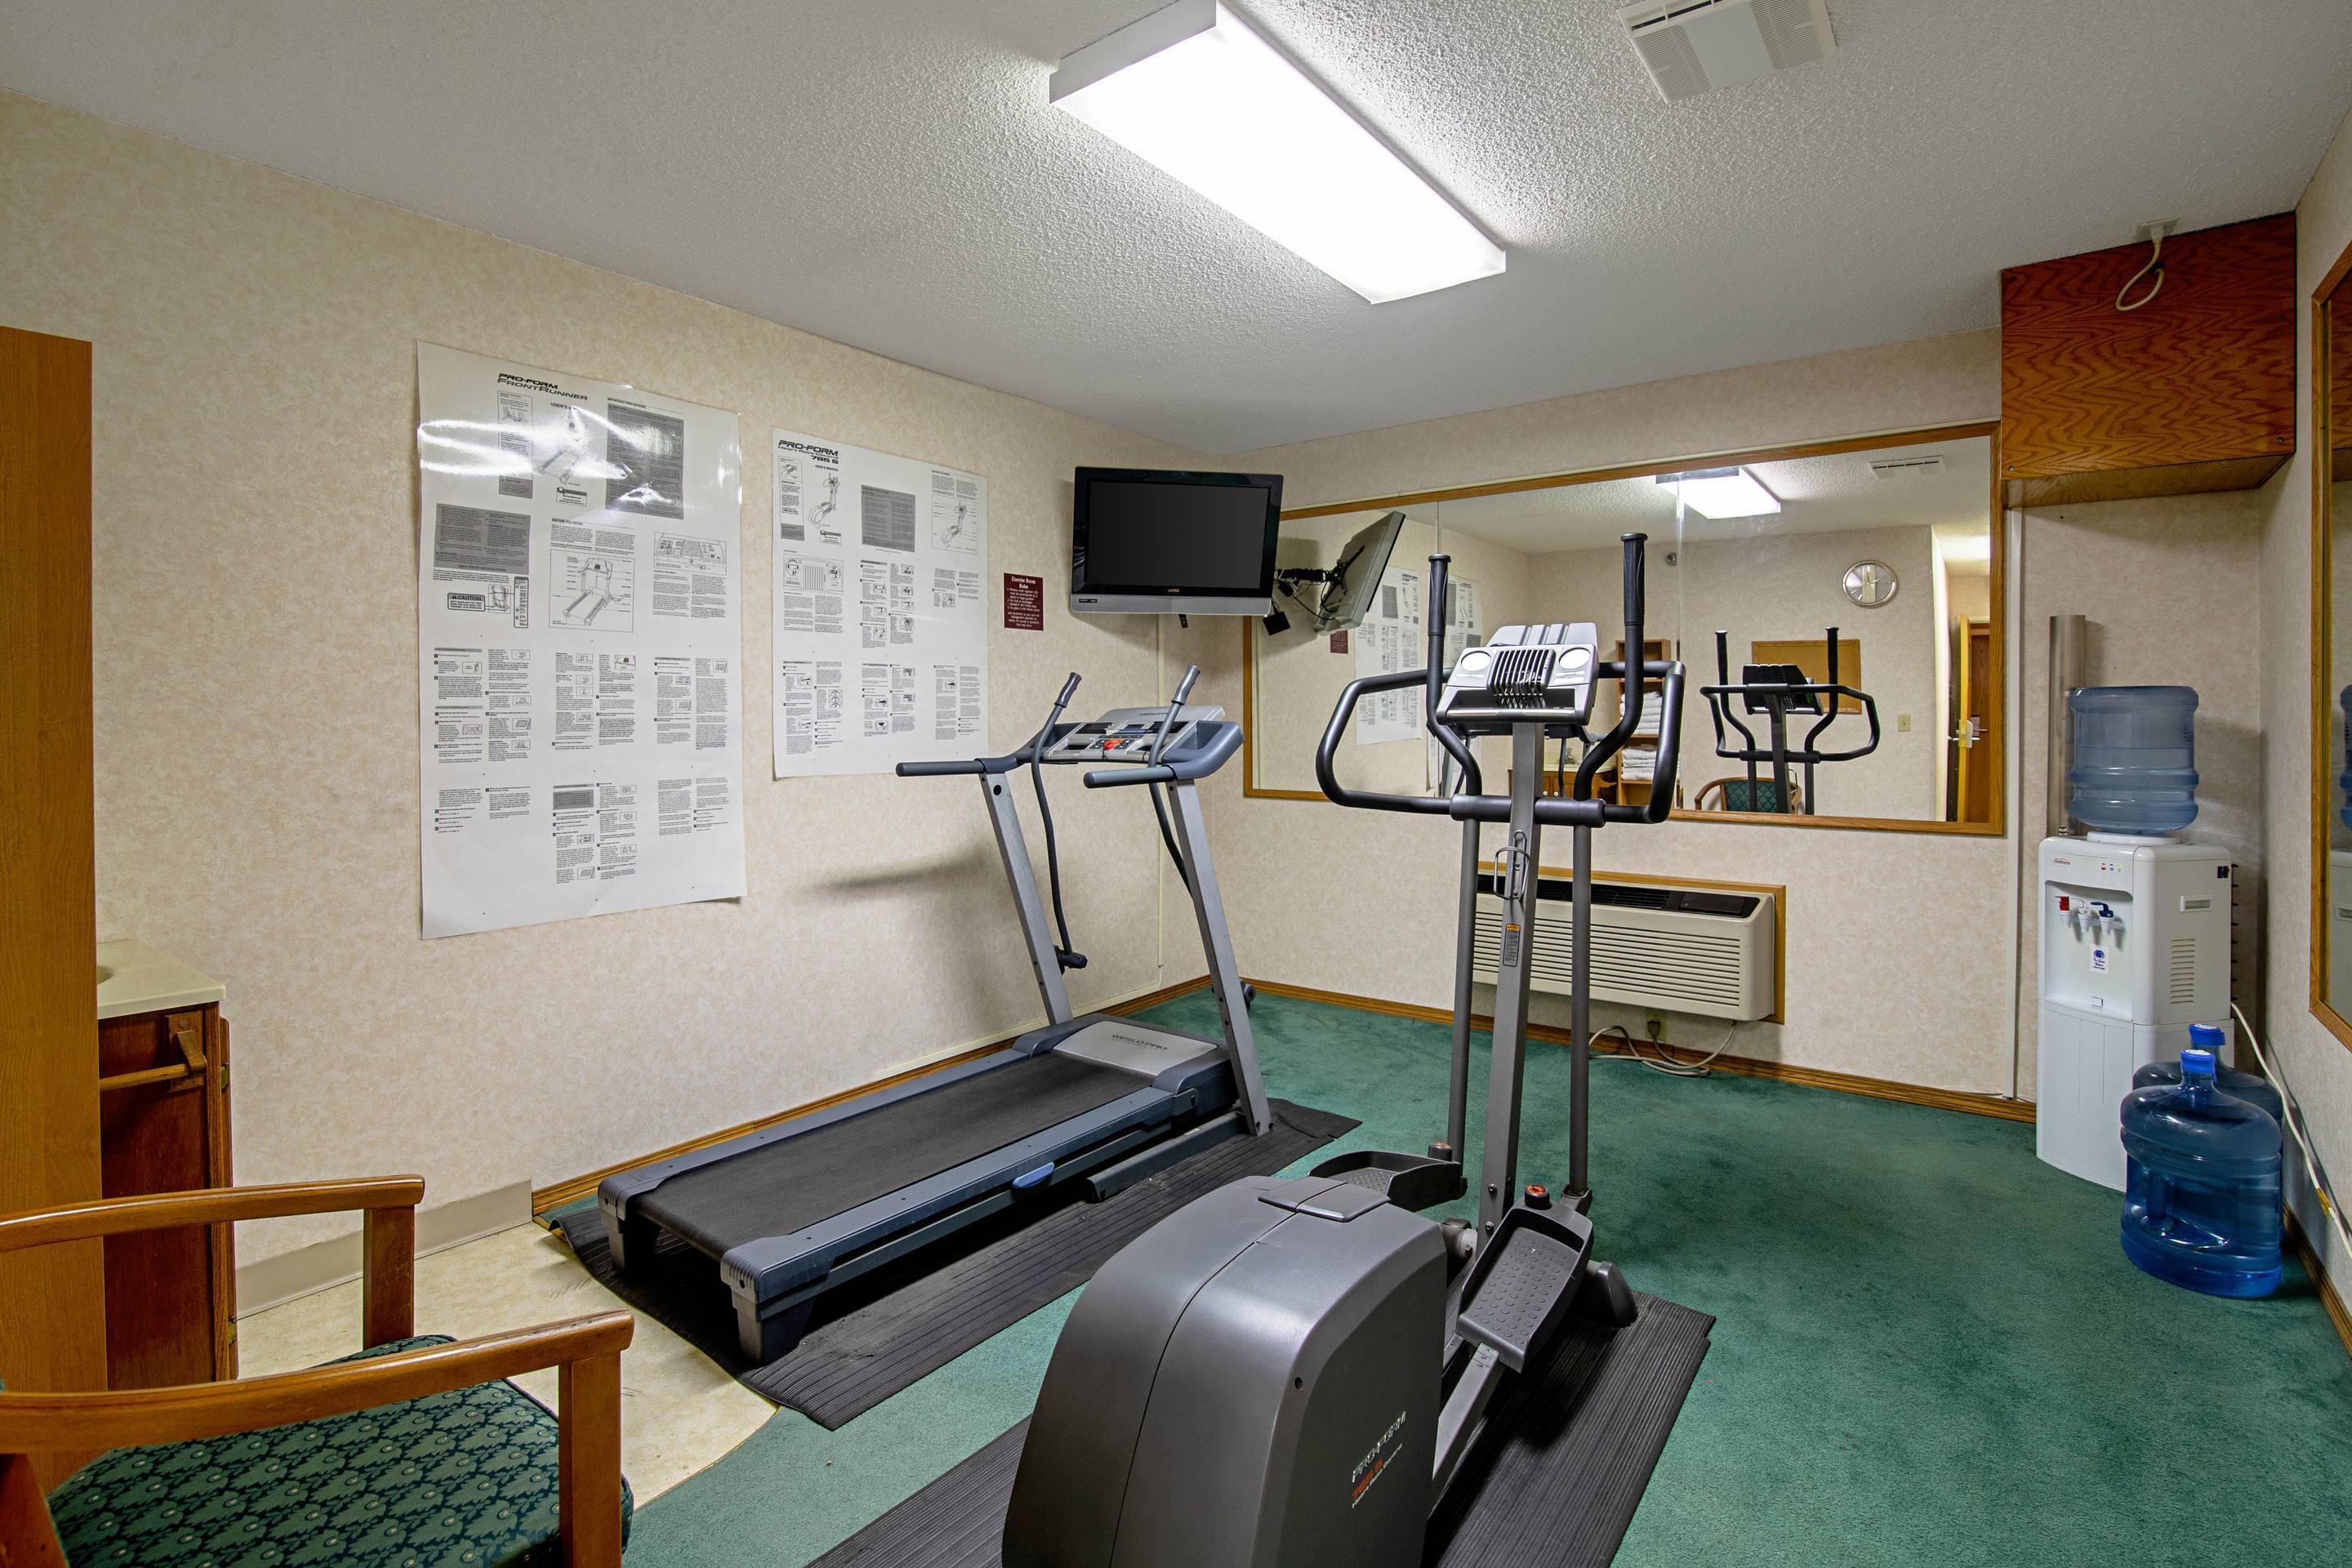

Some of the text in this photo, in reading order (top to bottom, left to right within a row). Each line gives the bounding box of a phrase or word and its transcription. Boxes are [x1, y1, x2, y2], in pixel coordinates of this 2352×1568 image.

[499, 373, 558, 389] PRO-FORM
[778, 439, 839, 457] PRO-FORM
[1352, 1411, 1405, 1483] PRO-FORM
